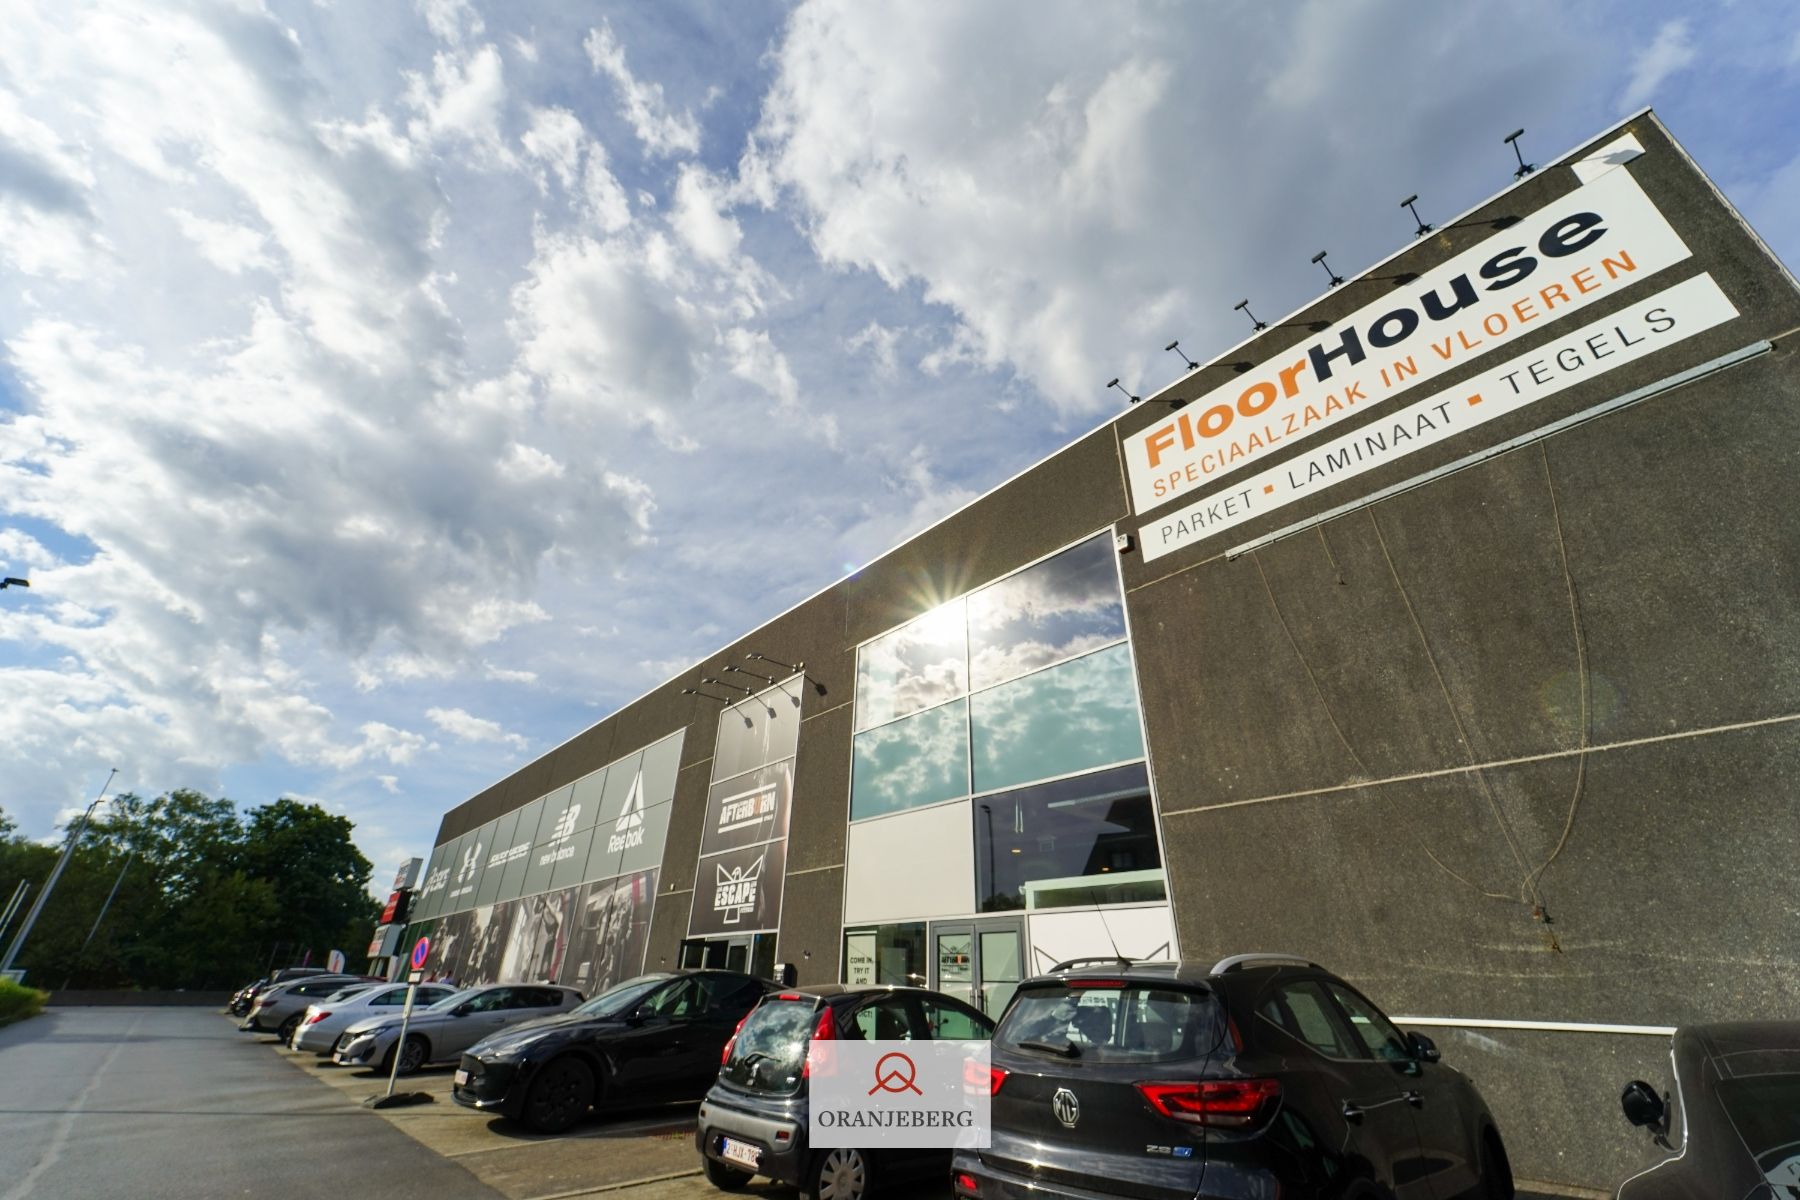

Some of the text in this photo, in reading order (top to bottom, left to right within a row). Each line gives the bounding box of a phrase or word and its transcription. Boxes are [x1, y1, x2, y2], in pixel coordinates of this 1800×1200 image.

[1144, 211, 1608, 469] FloorHouse
[1152, 249, 1637, 497] SPECIAALZAAK IN VLOEREN
[1161, 307, 1676, 544] PARKET LAMINAAT TEGELS
[714, 880, 757, 907] ESCAPE
